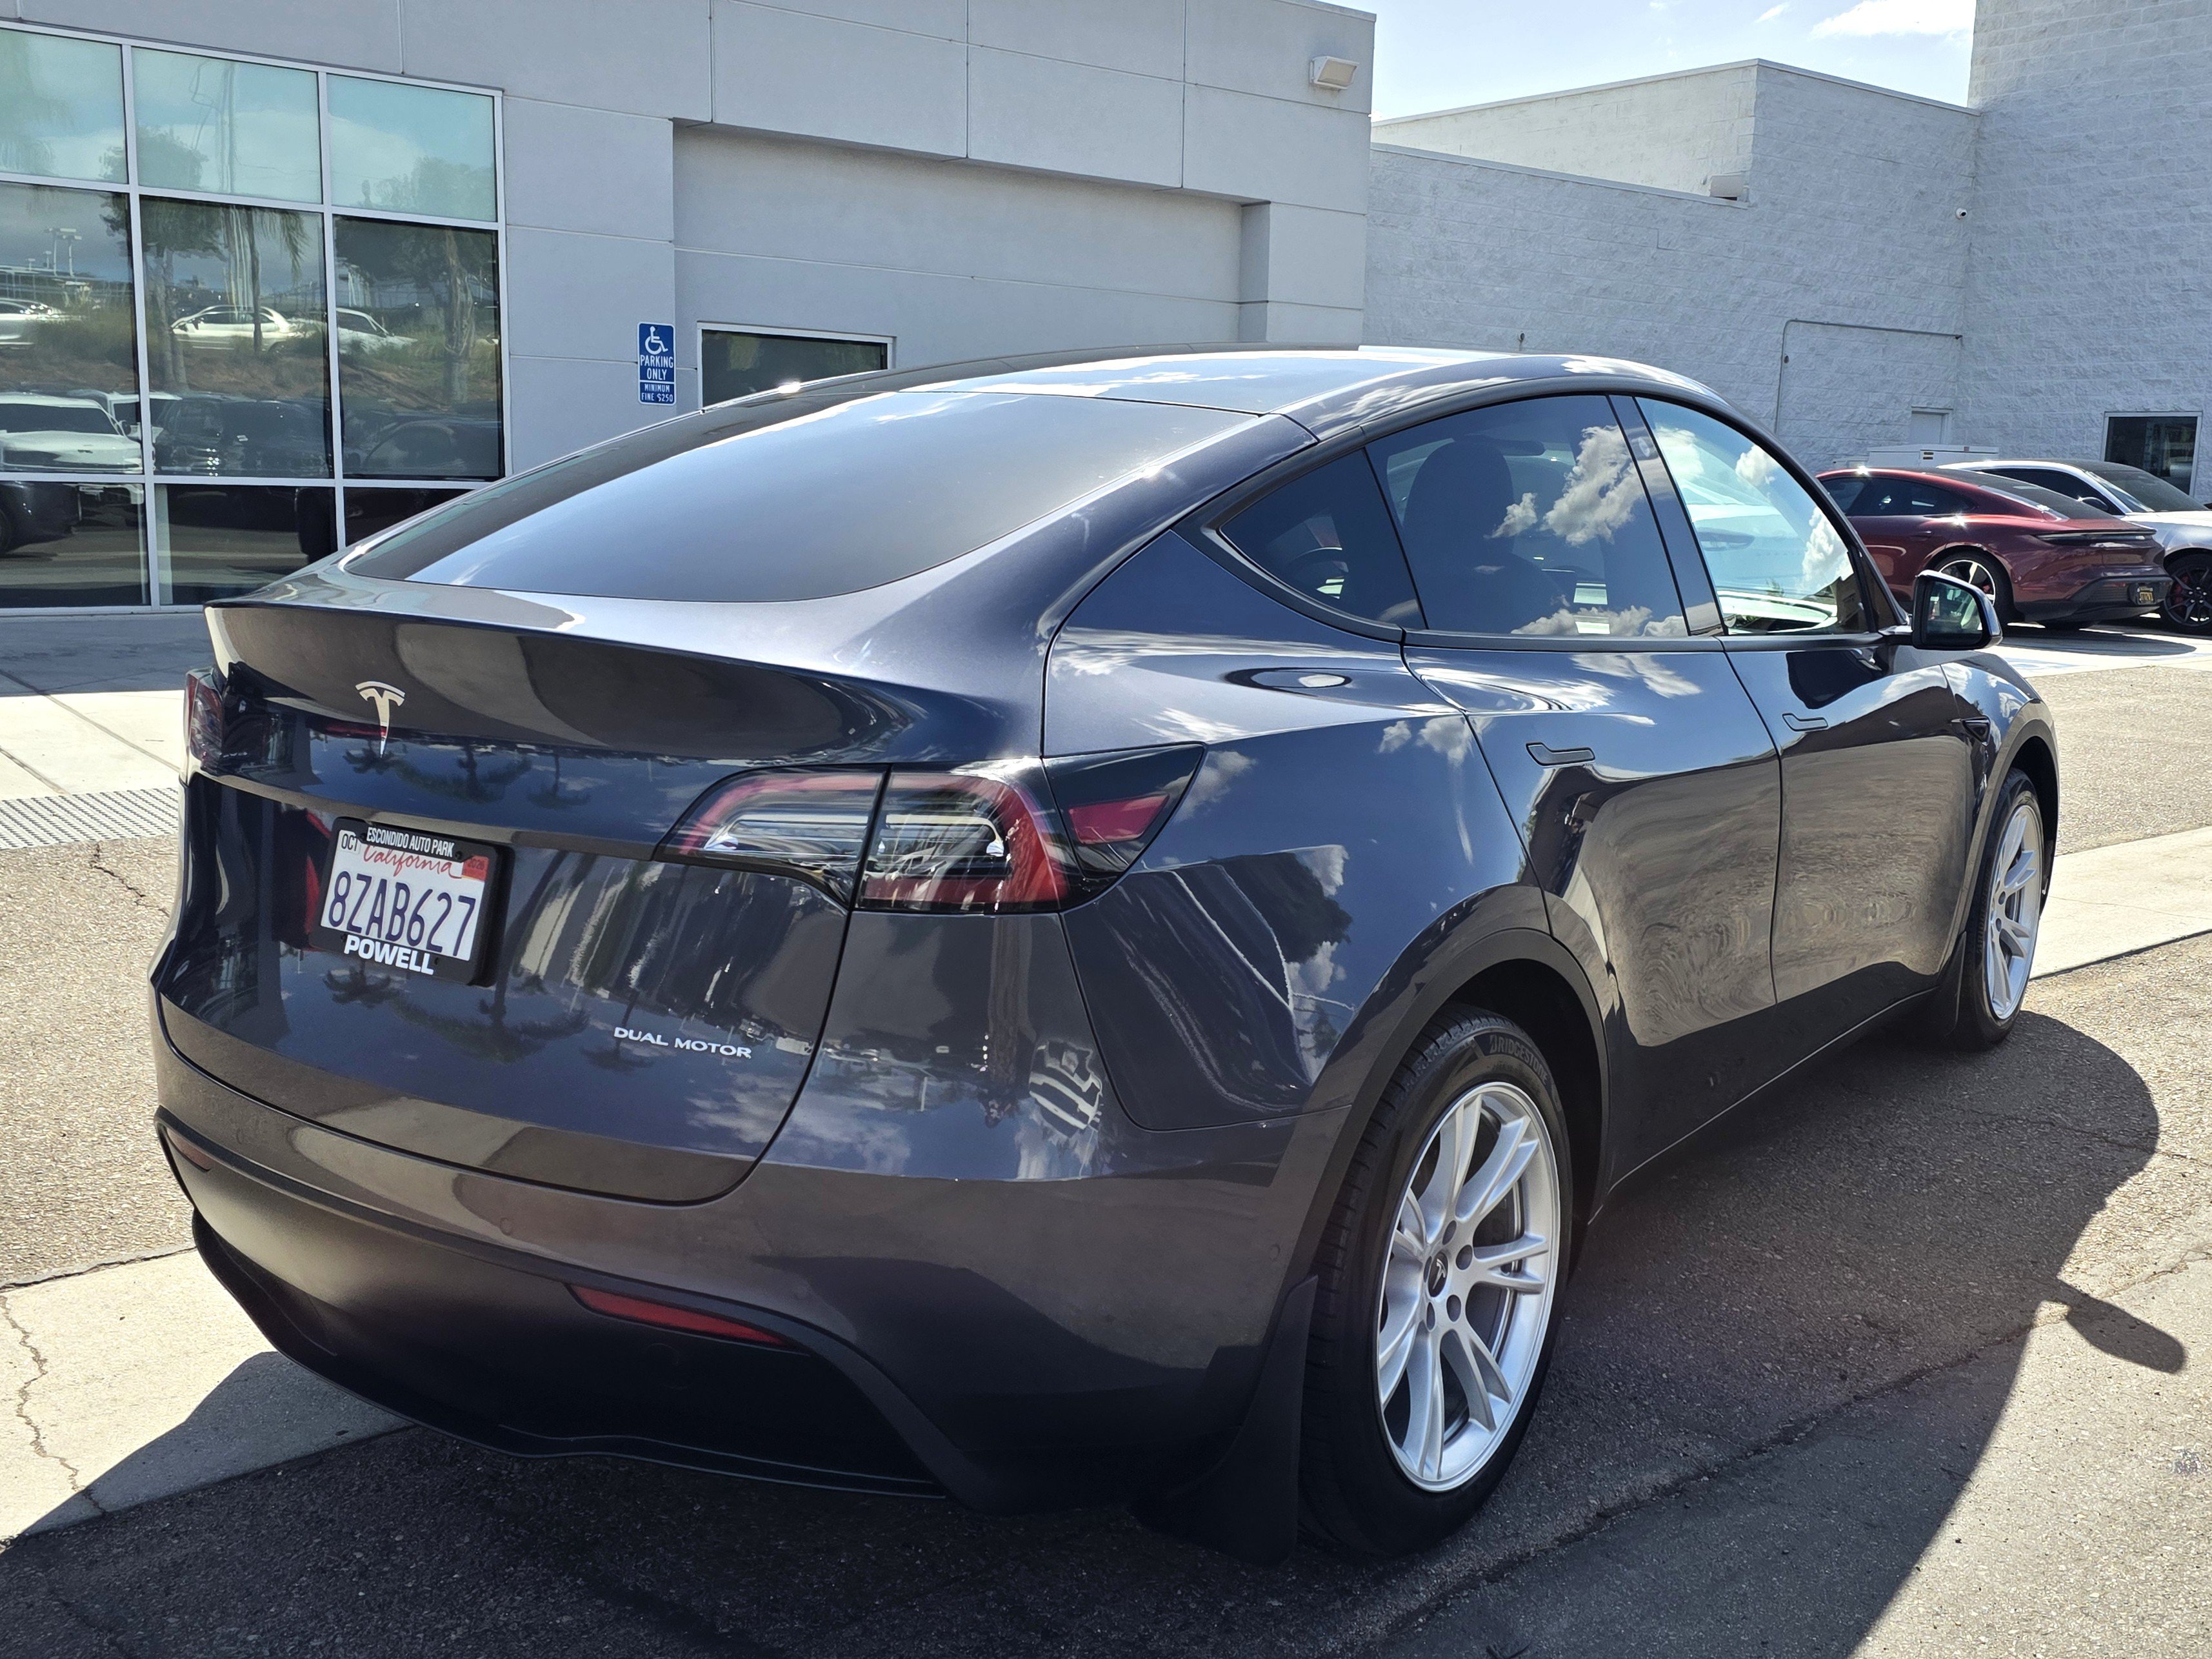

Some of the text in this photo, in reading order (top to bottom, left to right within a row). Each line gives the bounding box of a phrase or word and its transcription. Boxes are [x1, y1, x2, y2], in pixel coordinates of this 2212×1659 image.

[640, 355, 673, 368] PARKING
[647, 368, 667, 380] ONLY
[641, 392, 673, 402] FINE $250
[644, 383, 670, 392] MINIMUM
[341, 833, 358, 852] OCT
[366, 827, 455, 857] ESCONDIDO AUTO PARK
[363, 845, 463, 879] California
[328, 871, 476, 957] 8ZAB627
[344, 934, 434, 975] POWELL
[614, 1027, 752, 1059] DUAL MOTOR
